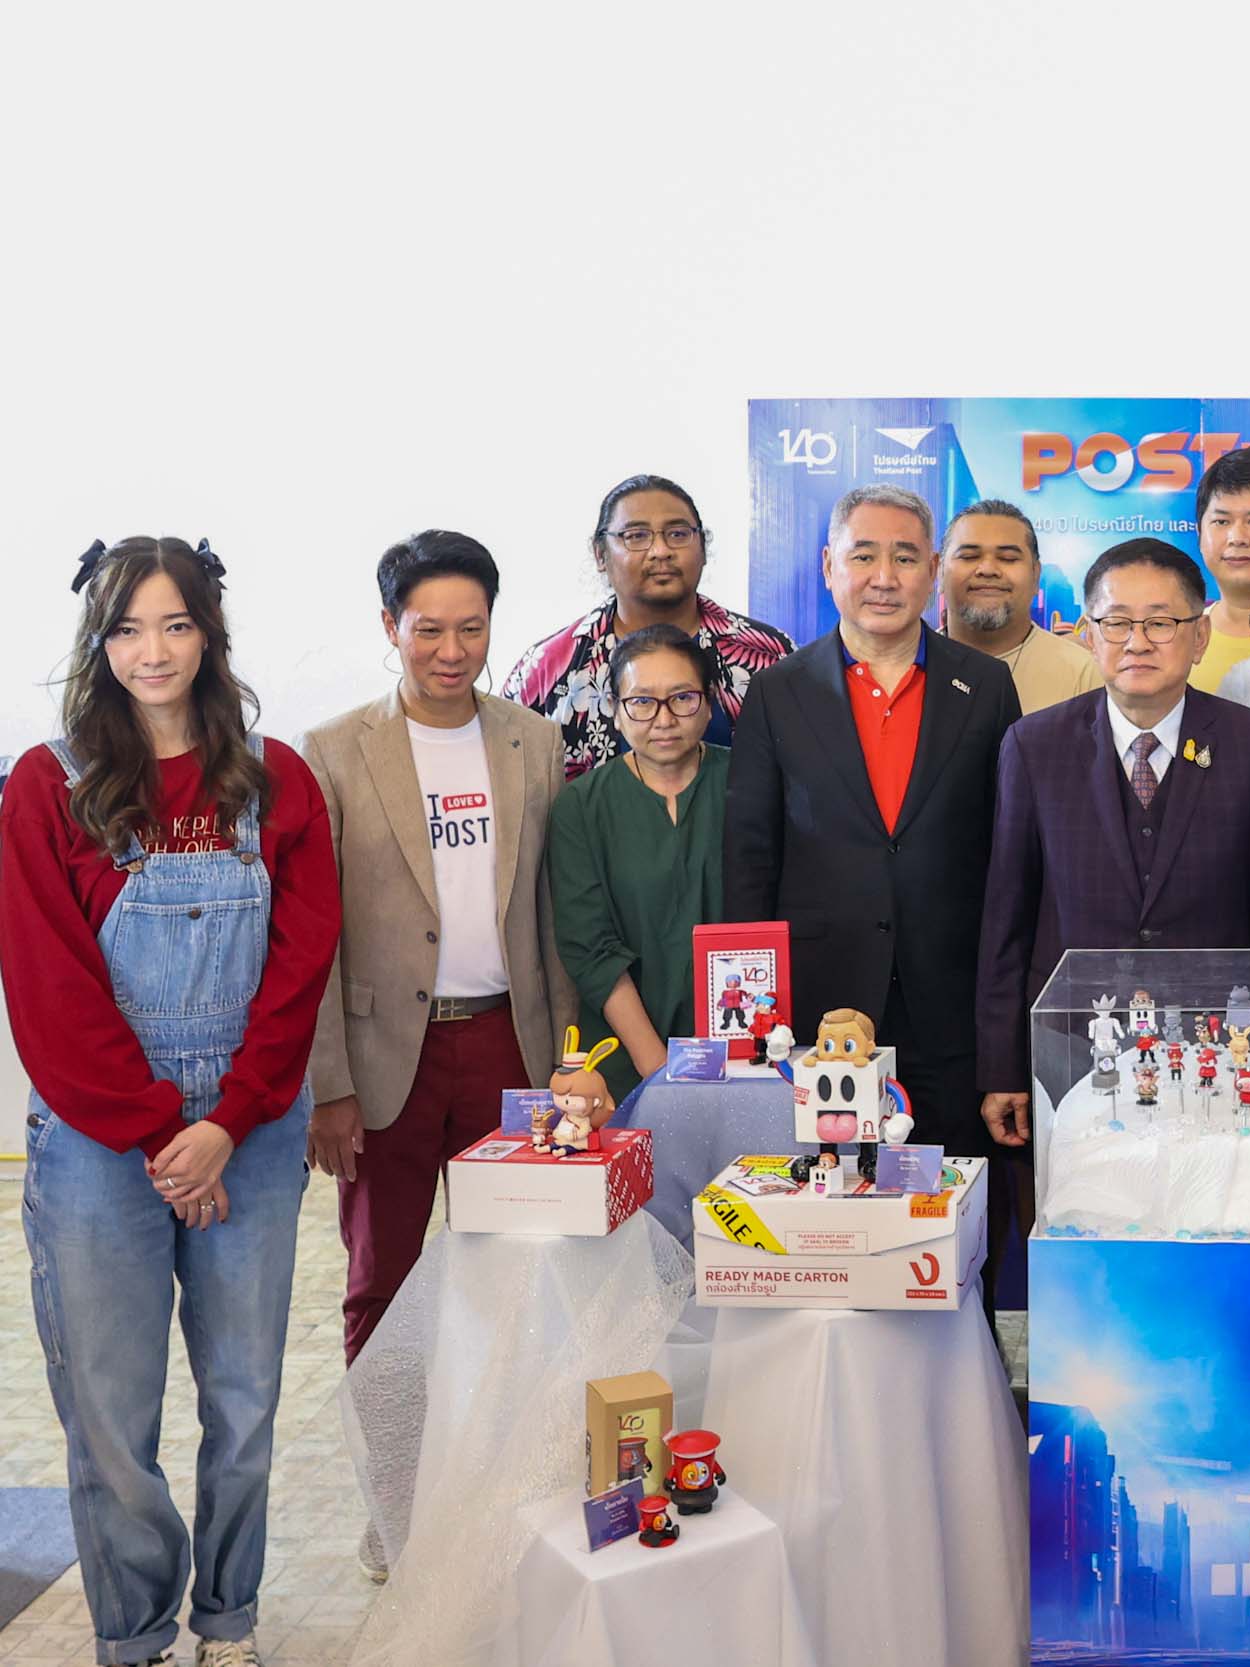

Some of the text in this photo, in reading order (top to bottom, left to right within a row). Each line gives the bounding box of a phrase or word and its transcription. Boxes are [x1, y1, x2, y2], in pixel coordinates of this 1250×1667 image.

[1033, 517, 1053, 533] 40
[427, 794, 473, 820] I LOVE
[430, 817, 490, 849] POST
[911, 1206, 948, 1217] FRAGILE
[705, 1271, 849, 1283] READY MADE CARTON
[706, 1282, 777, 1297] กล่องสำเร็จรูป
